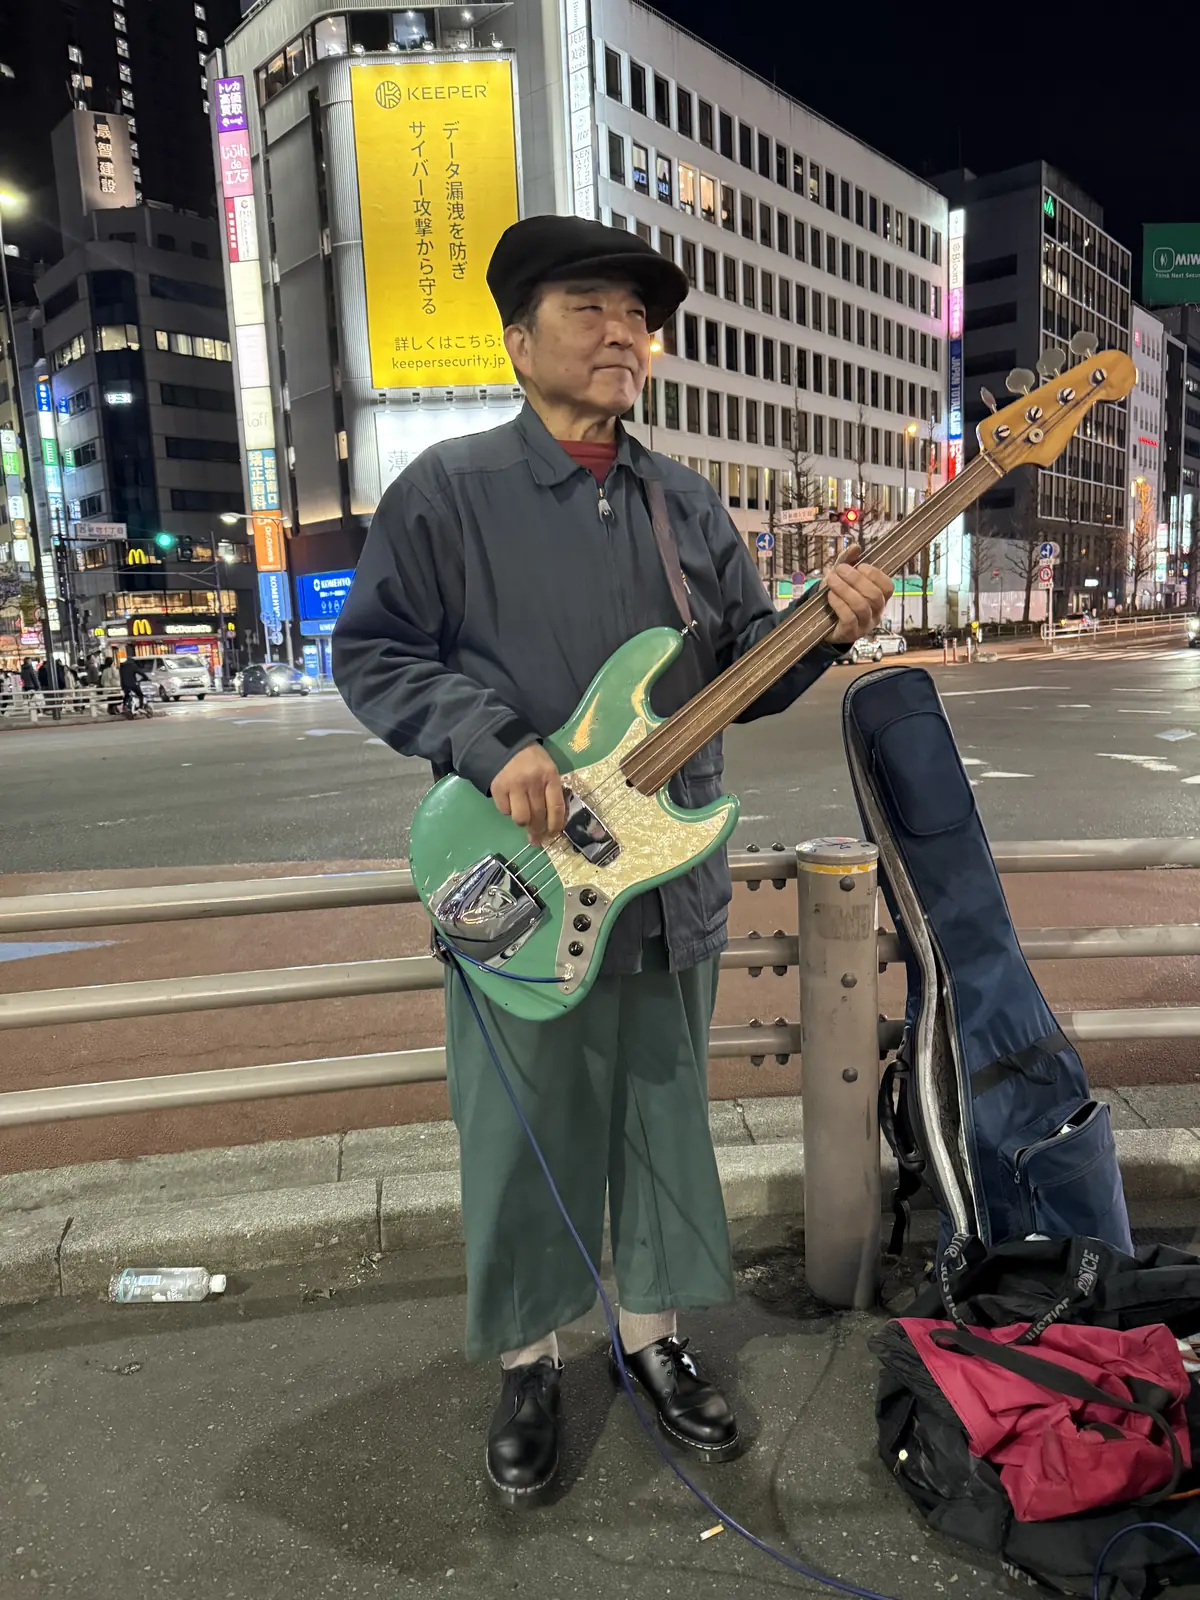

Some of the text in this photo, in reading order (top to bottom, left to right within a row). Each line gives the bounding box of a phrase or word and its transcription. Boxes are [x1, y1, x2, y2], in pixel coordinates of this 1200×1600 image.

[219, 81, 240, 93] トレカ
[408, 84, 487, 101] KEEPER
[222, 144, 249, 160] じぶん
[230, 159, 242, 170] de
[225, 169, 249, 185] エステ
[442, 120, 468, 280] データ漏洩を防ぎ
[409, 121, 437, 315] サイバー攻撃から守る
[394, 334, 502, 352] 詳しくはこちら:
[391, 353, 506, 372] keepersecurity.jp
[951, 356, 961, 385] JAPAN
[951, 385, 961, 412] TOTAL
[250, 451, 267, 510] 矯正歯科
[263, 456, 278, 505] 新宿南口
